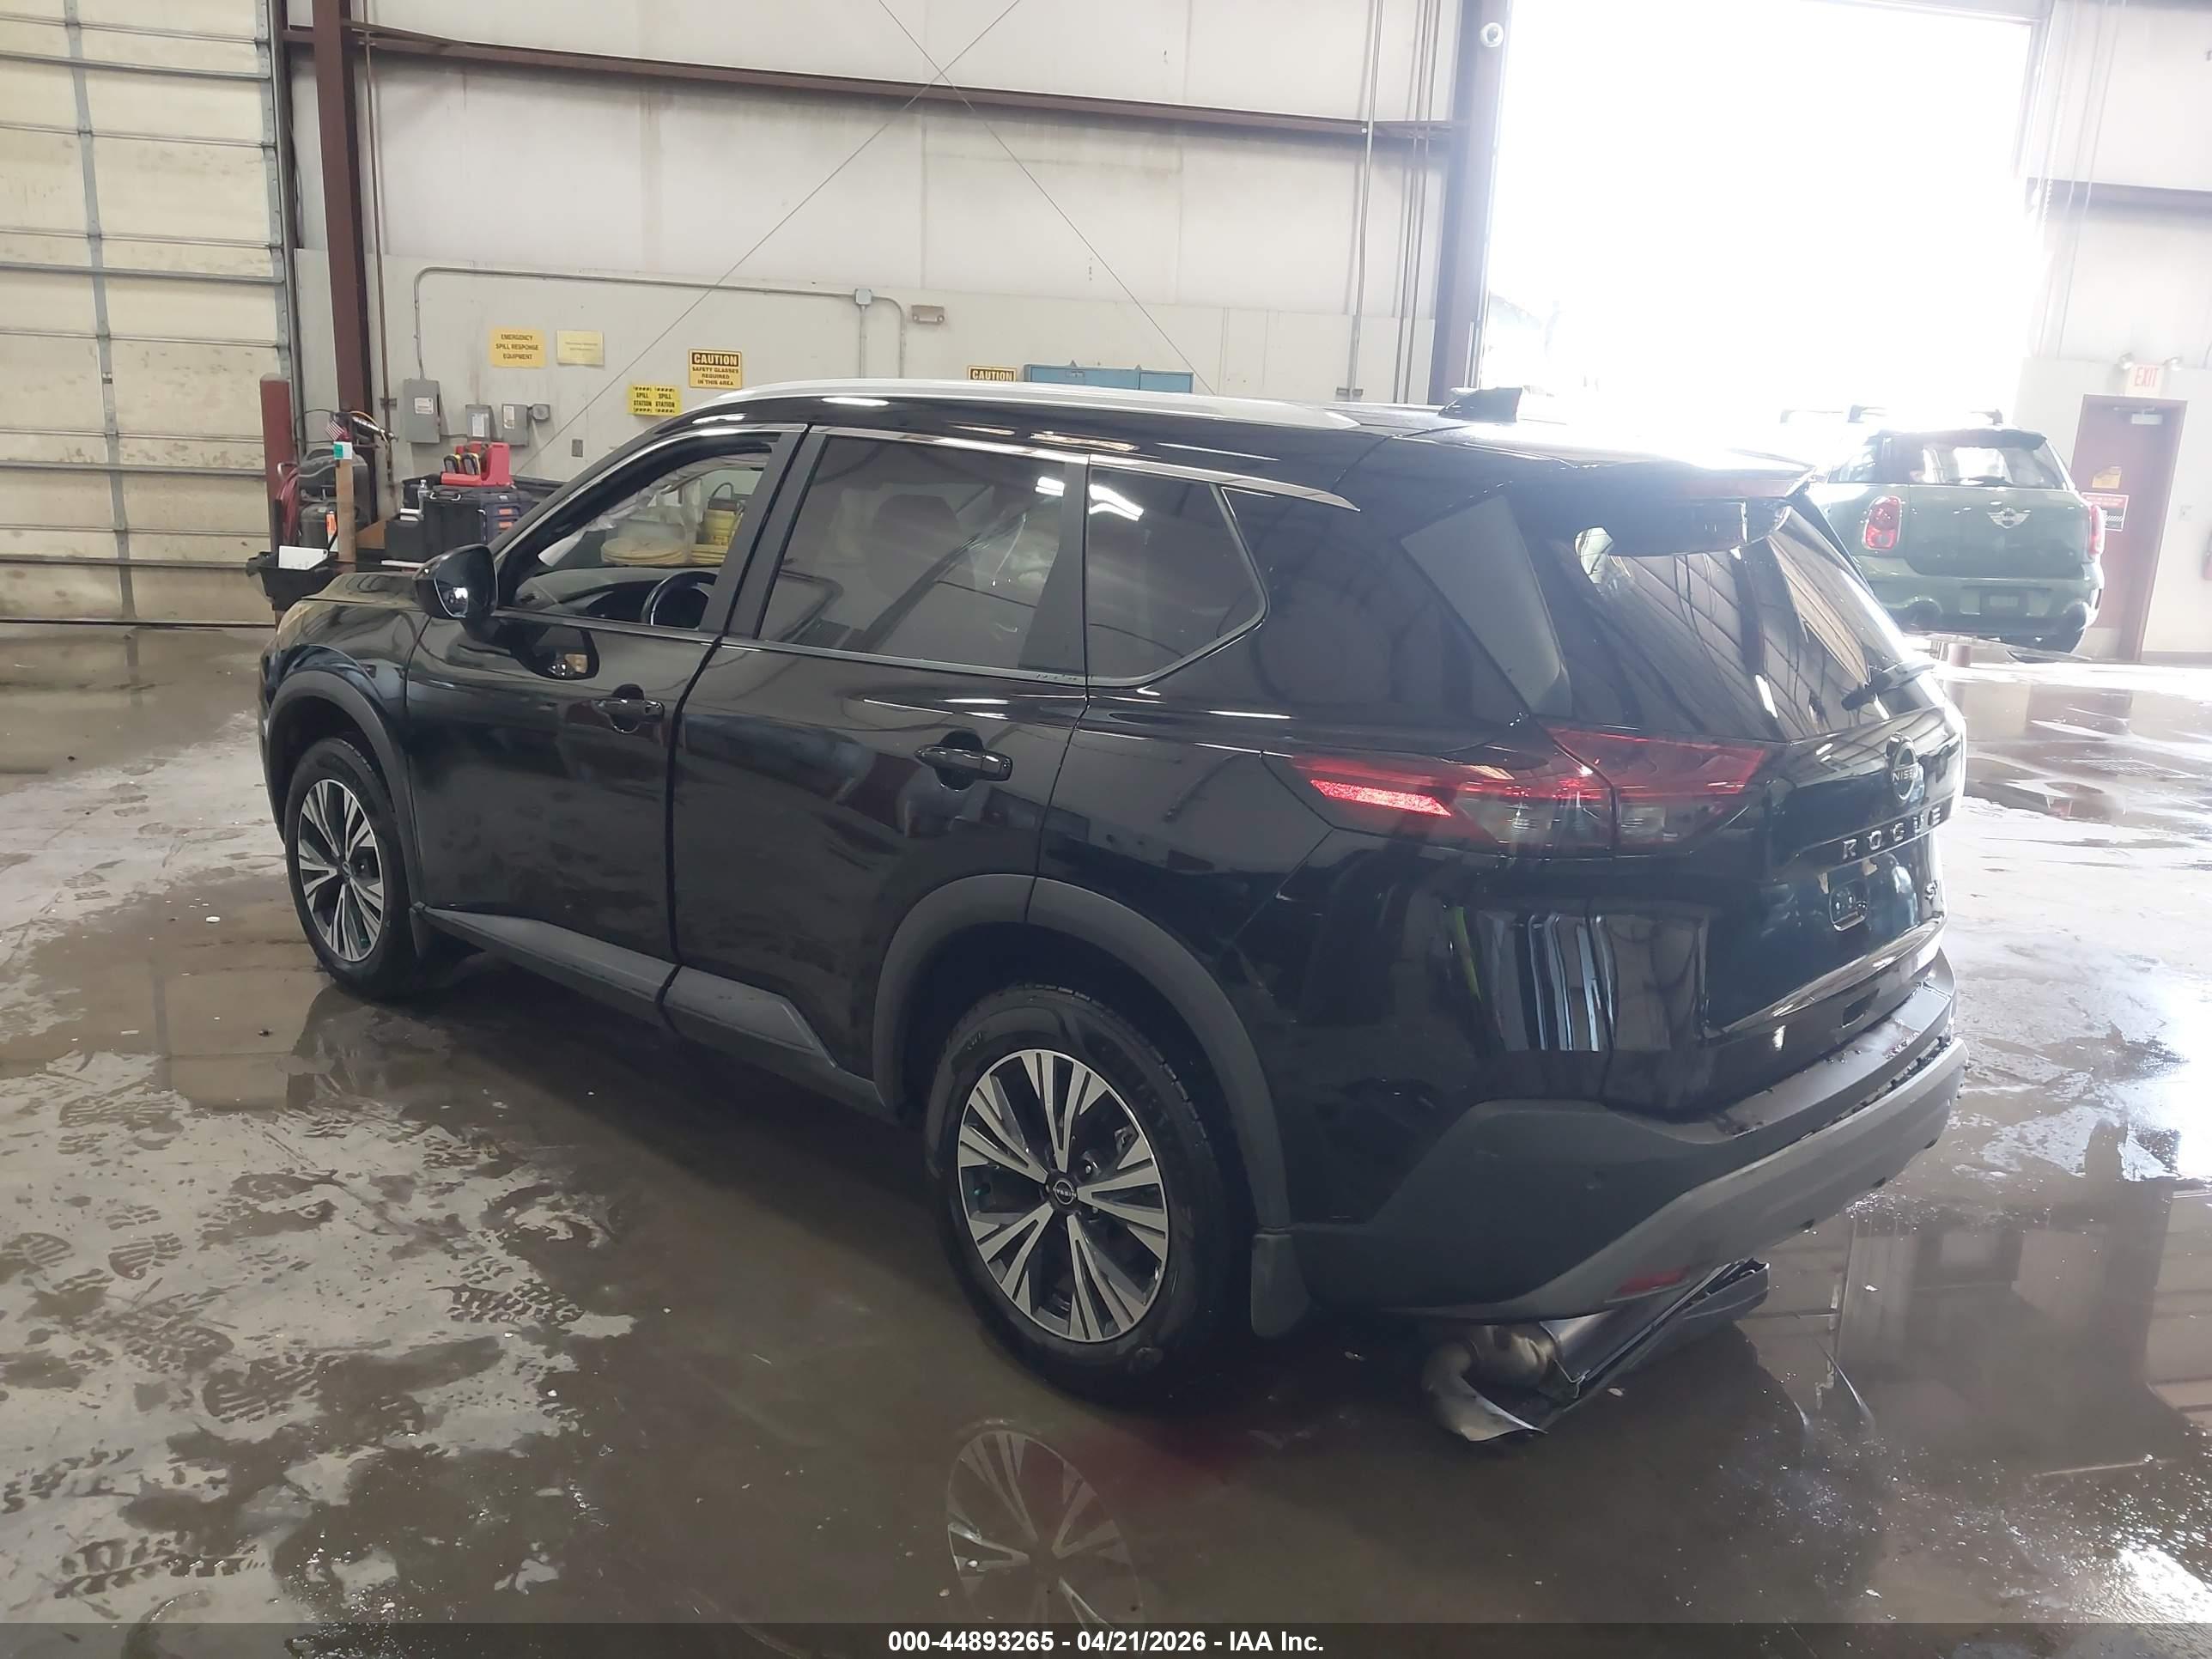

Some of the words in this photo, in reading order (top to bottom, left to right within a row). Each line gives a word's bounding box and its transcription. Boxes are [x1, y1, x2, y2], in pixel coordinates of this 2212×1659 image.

[693, 353, 738, 366] CAUTION
[971, 369, 1013, 381] CAUTION
[2134, 367, 2160, 387] EXIT
[1842, 806, 1942, 860] ROGUE
